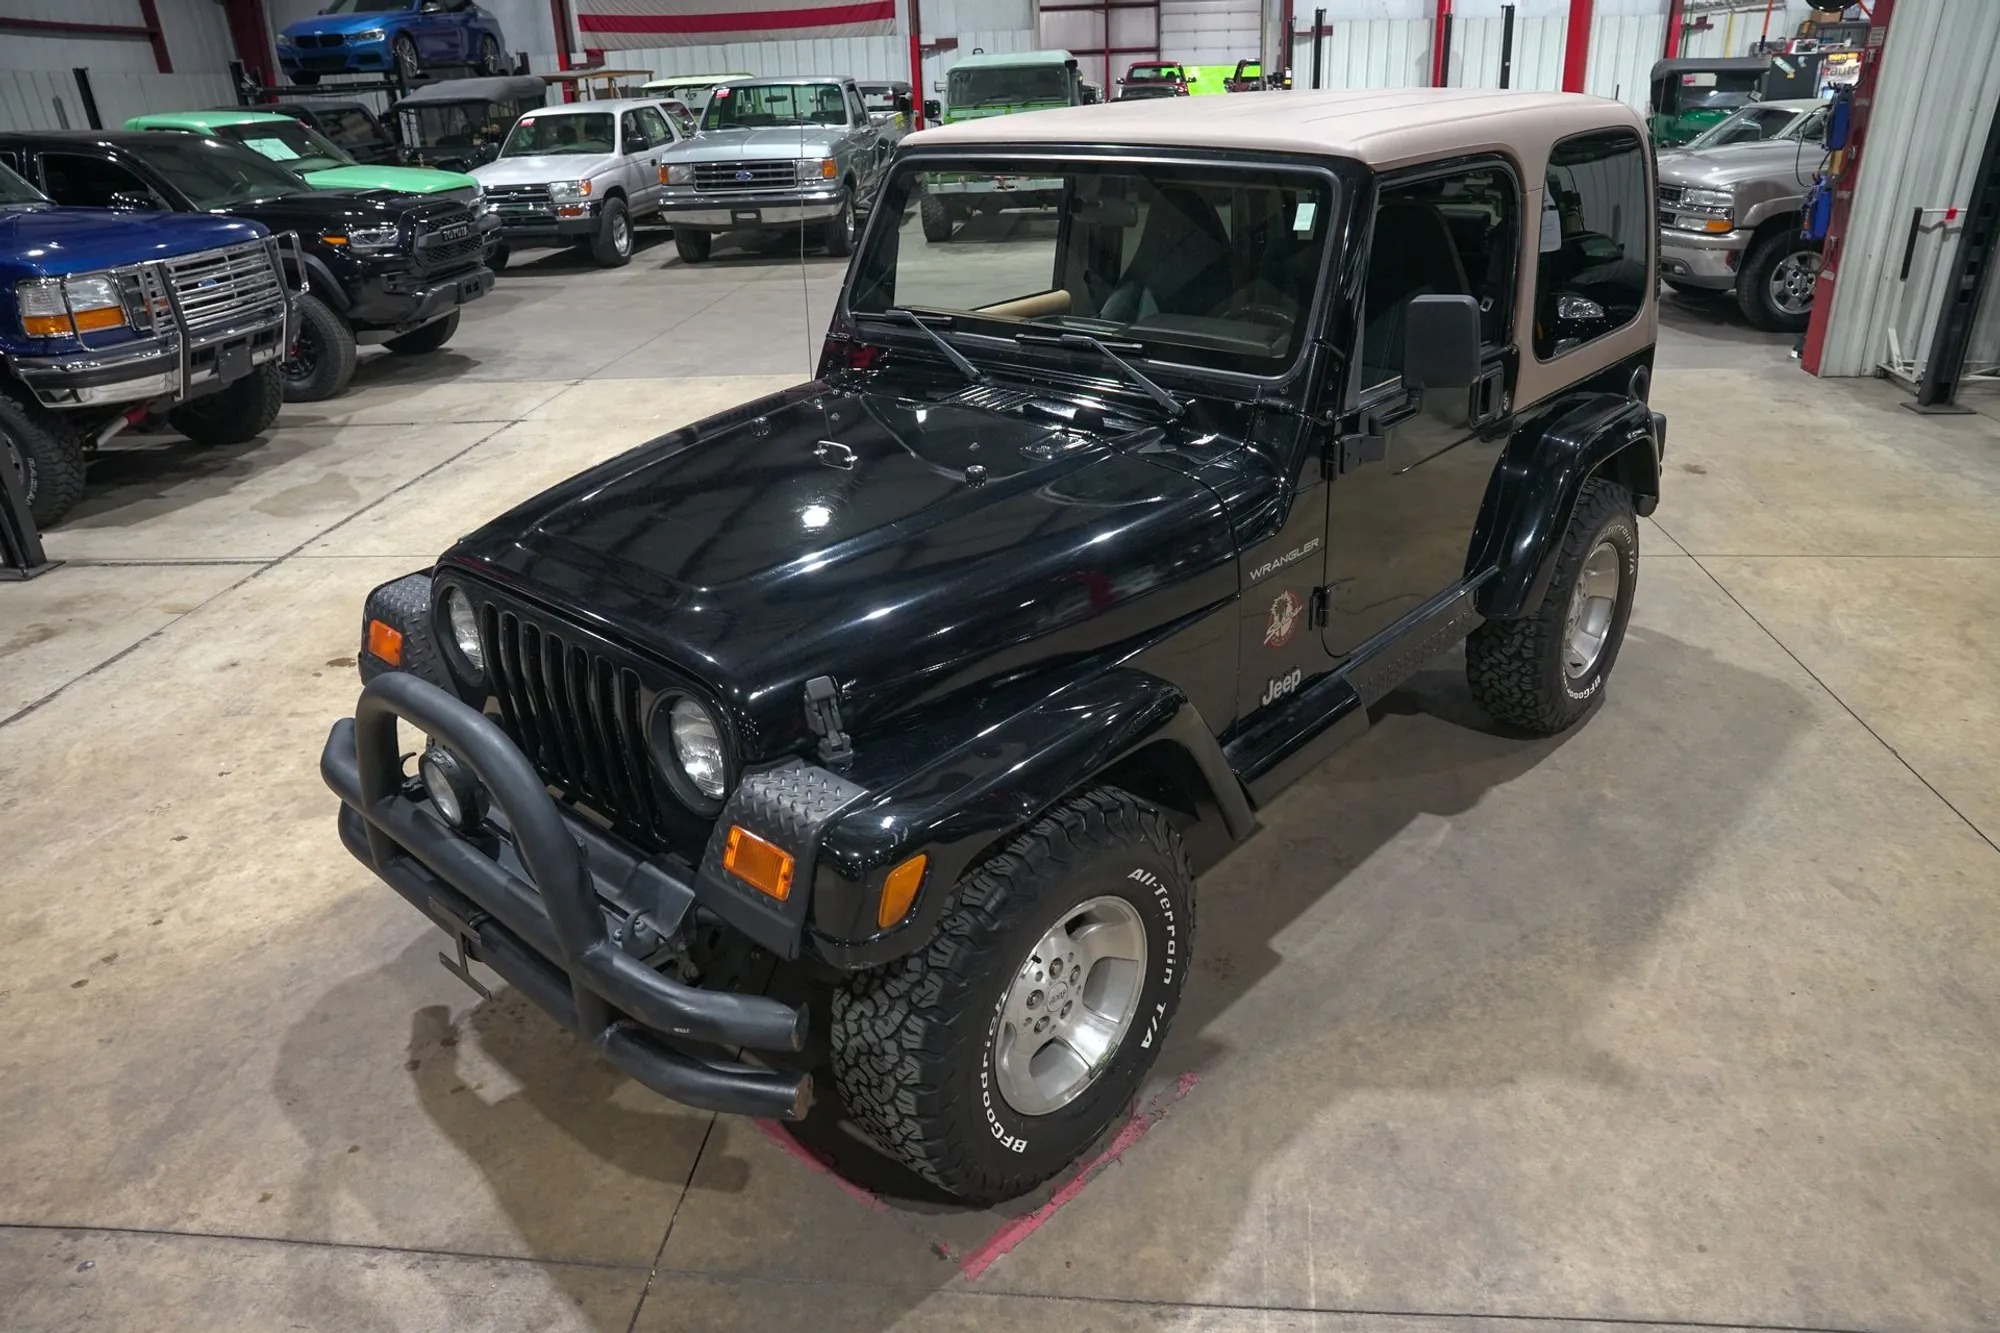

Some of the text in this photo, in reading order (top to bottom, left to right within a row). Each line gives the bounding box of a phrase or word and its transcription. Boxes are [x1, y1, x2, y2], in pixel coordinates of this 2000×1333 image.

[443, 225, 467, 240] TOYOTA
[1249, 537, 1319, 580] WRANGLER
[1262, 669, 1301, 705] Jeep
[1127, 867, 1177, 1049] All-Terrain T/A
